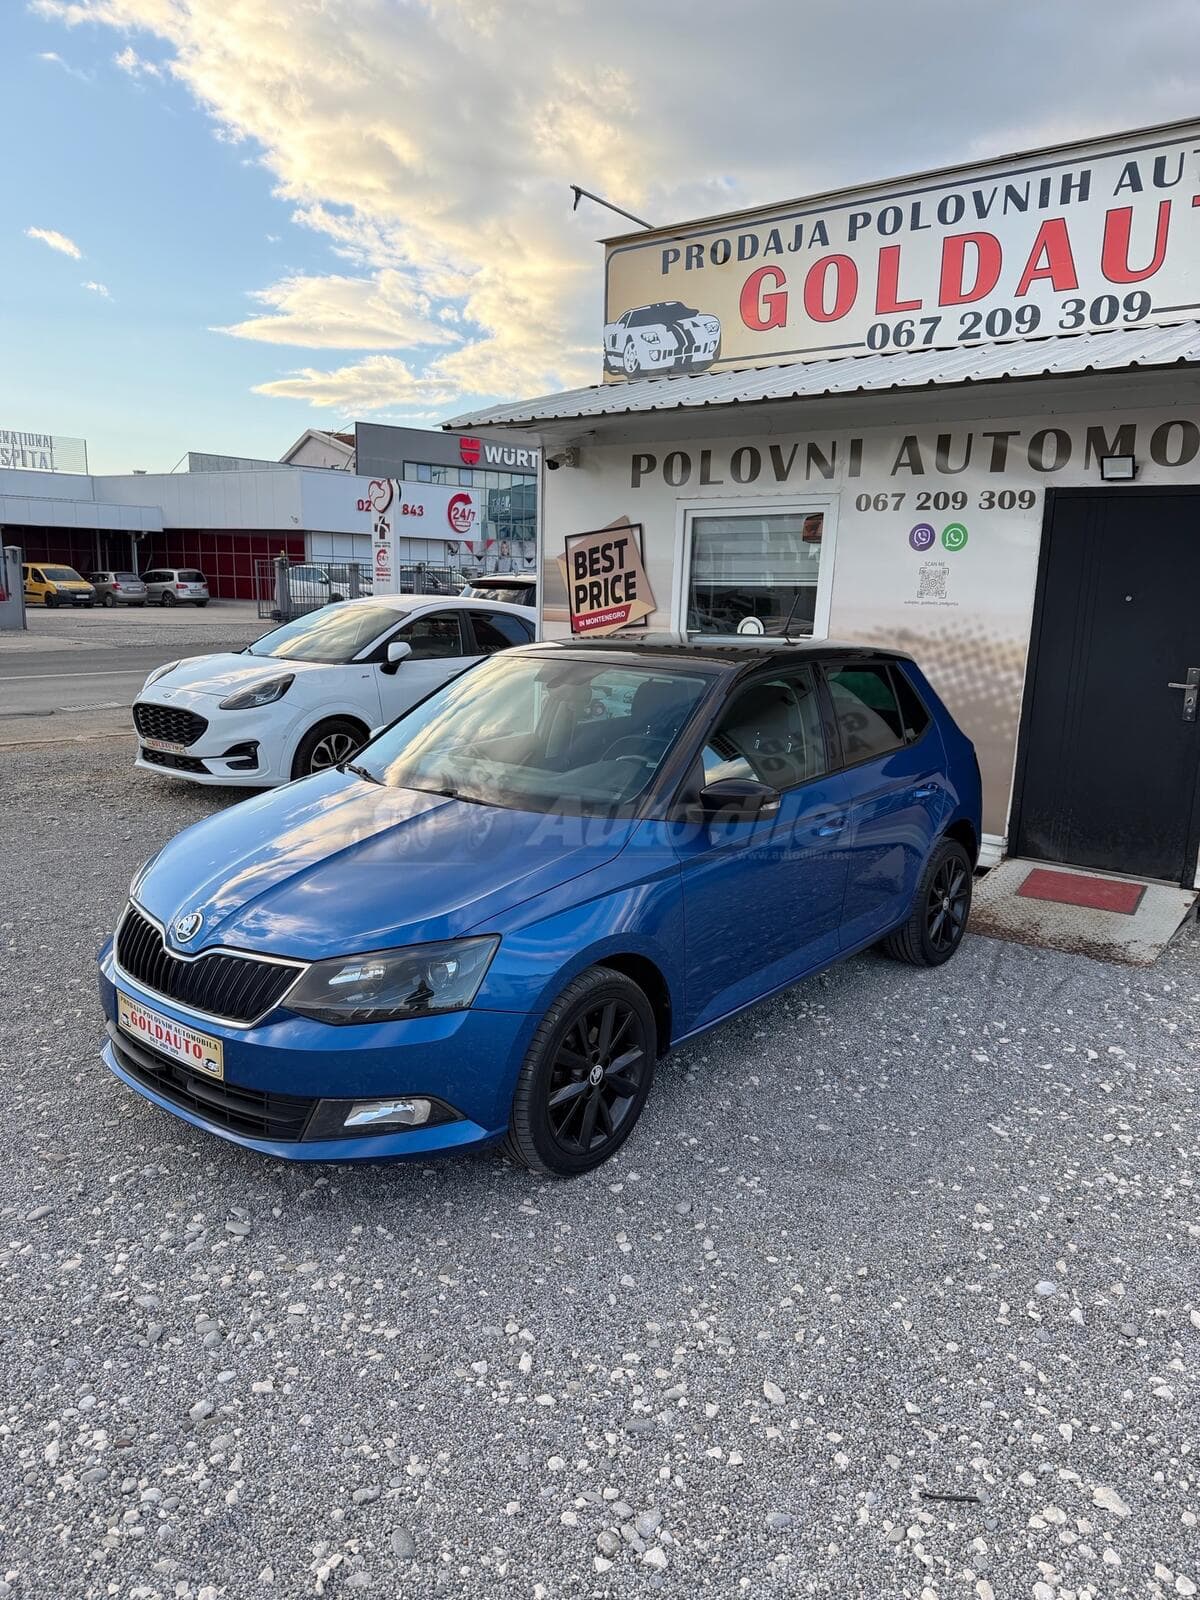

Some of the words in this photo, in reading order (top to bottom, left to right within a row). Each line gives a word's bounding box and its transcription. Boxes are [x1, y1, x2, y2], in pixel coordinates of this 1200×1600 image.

[661, 220, 829, 274] PRODAJA
[848, 170, 1091, 242] POLOVNIH
[740, 195, 1200, 332] GOLDAU
[866, 316, 943, 350] 067
[958, 303, 1041, 341] 209
[1058, 290, 1153, 329] 309
[631, 438, 864, 488] POLOVNI
[402, 503, 424, 517] 843
[452, 506, 476, 521] 24/7
[855, 493, 907, 513] 067
[915, 491, 968, 511] 209
[978, 489, 1036, 510] 309
[574, 538, 629, 581] BEST
[574, 570, 637, 614] PRICE
[585, 610, 626, 625] MONTENEGRO
[130, 1011, 203, 1059] GOLDAUTO
[174, 1027, 218, 1051] AUTOMOBILA
